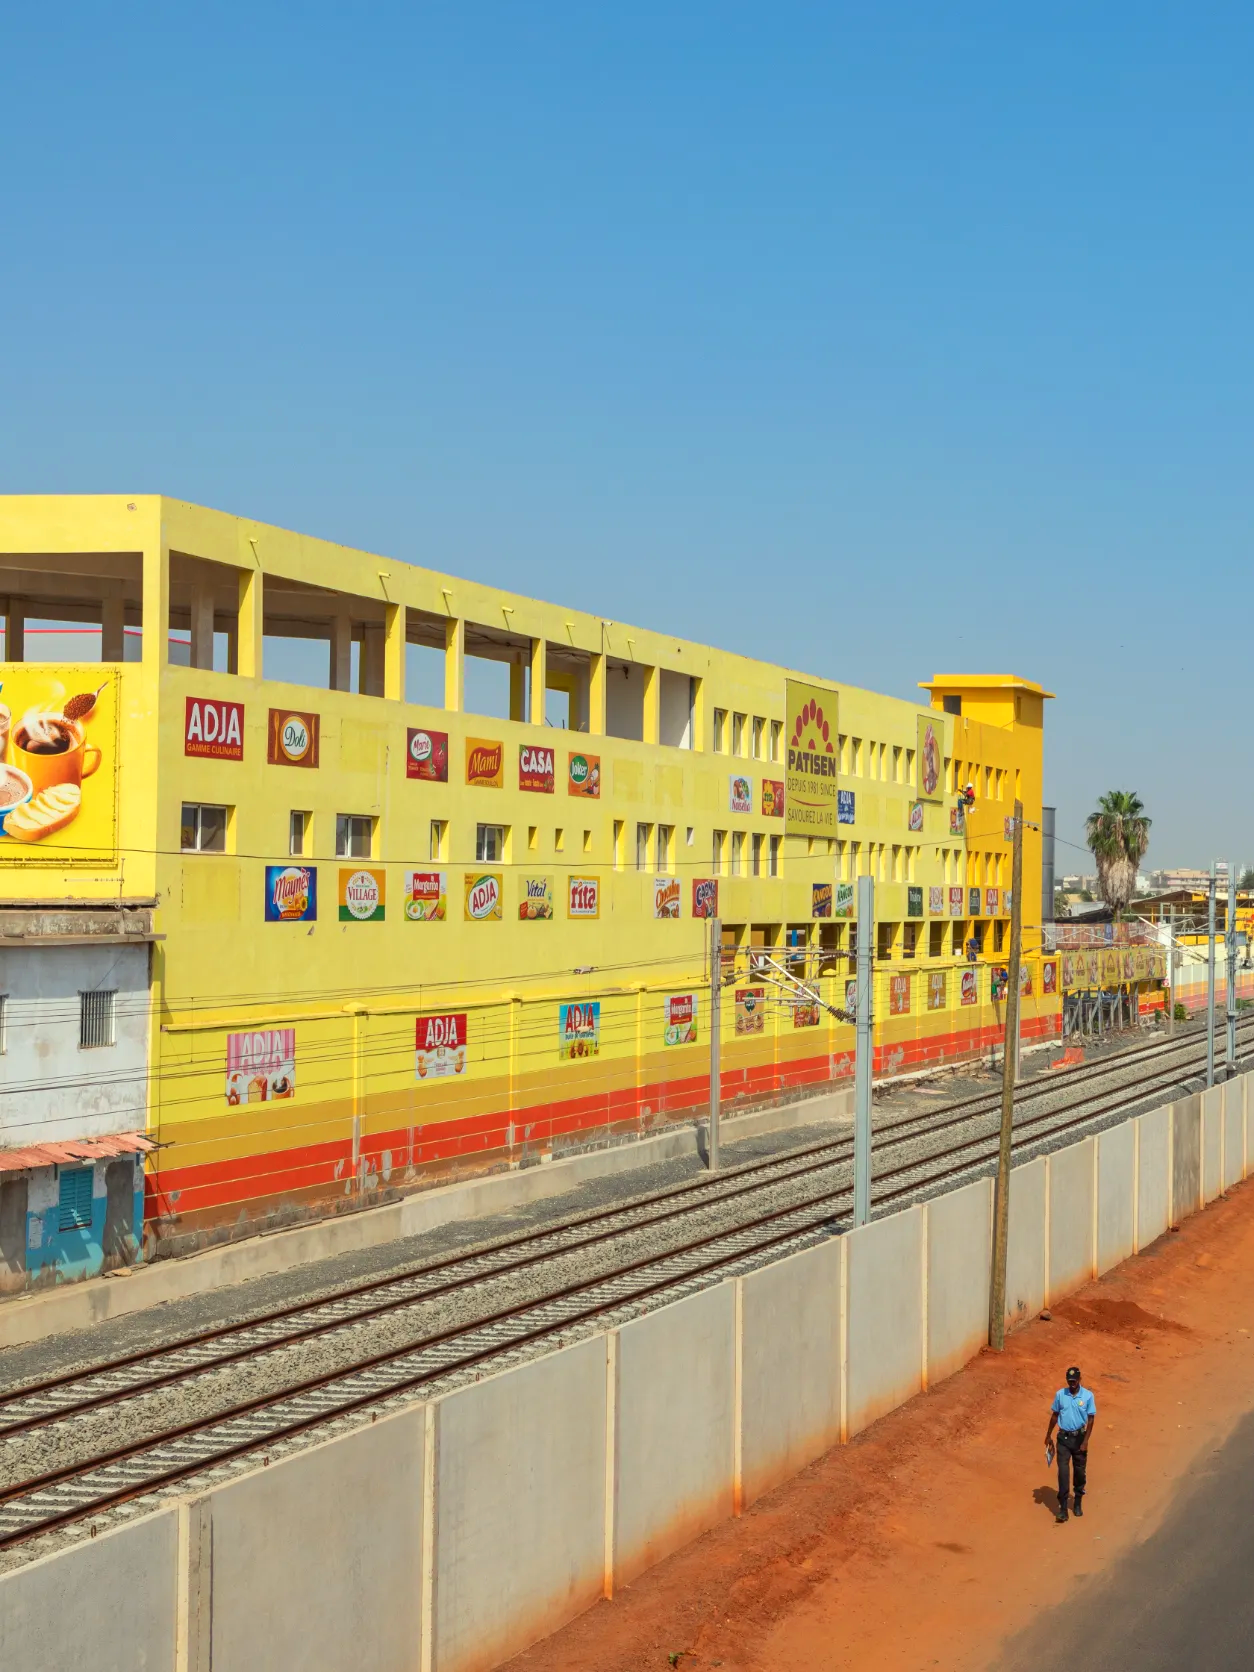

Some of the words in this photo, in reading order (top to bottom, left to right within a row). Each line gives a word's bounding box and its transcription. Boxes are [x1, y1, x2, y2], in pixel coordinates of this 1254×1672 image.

[187, 702, 242, 746] ADJA
[284, 726, 306, 748] Doli
[187, 742, 210, 754] GAMME
[211, 744, 241, 756] CULINAIRE
[470, 749, 499, 775] Mami
[520, 749, 553, 775] CASA
[788, 749, 836, 777] PATISEN
[788, 778, 806, 793] DEPUIS
[808, 781, 819, 794] 1981
[820, 783, 836, 797] SINCE
[788, 808, 815, 824] SAVOUREZ
[817, 812, 823, 825] LA
[825, 812, 833, 825] VIE
[347, 886, 377, 901] VILLAGE
[472, 881, 496, 913] ADJA
[526, 878, 547, 897] Vital
[571, 882, 596, 909] rita
[565, 1003, 595, 1033] ADJA
[425, 1017, 458, 1047] ADJA
[240, 1031, 284, 1067] ADJA
